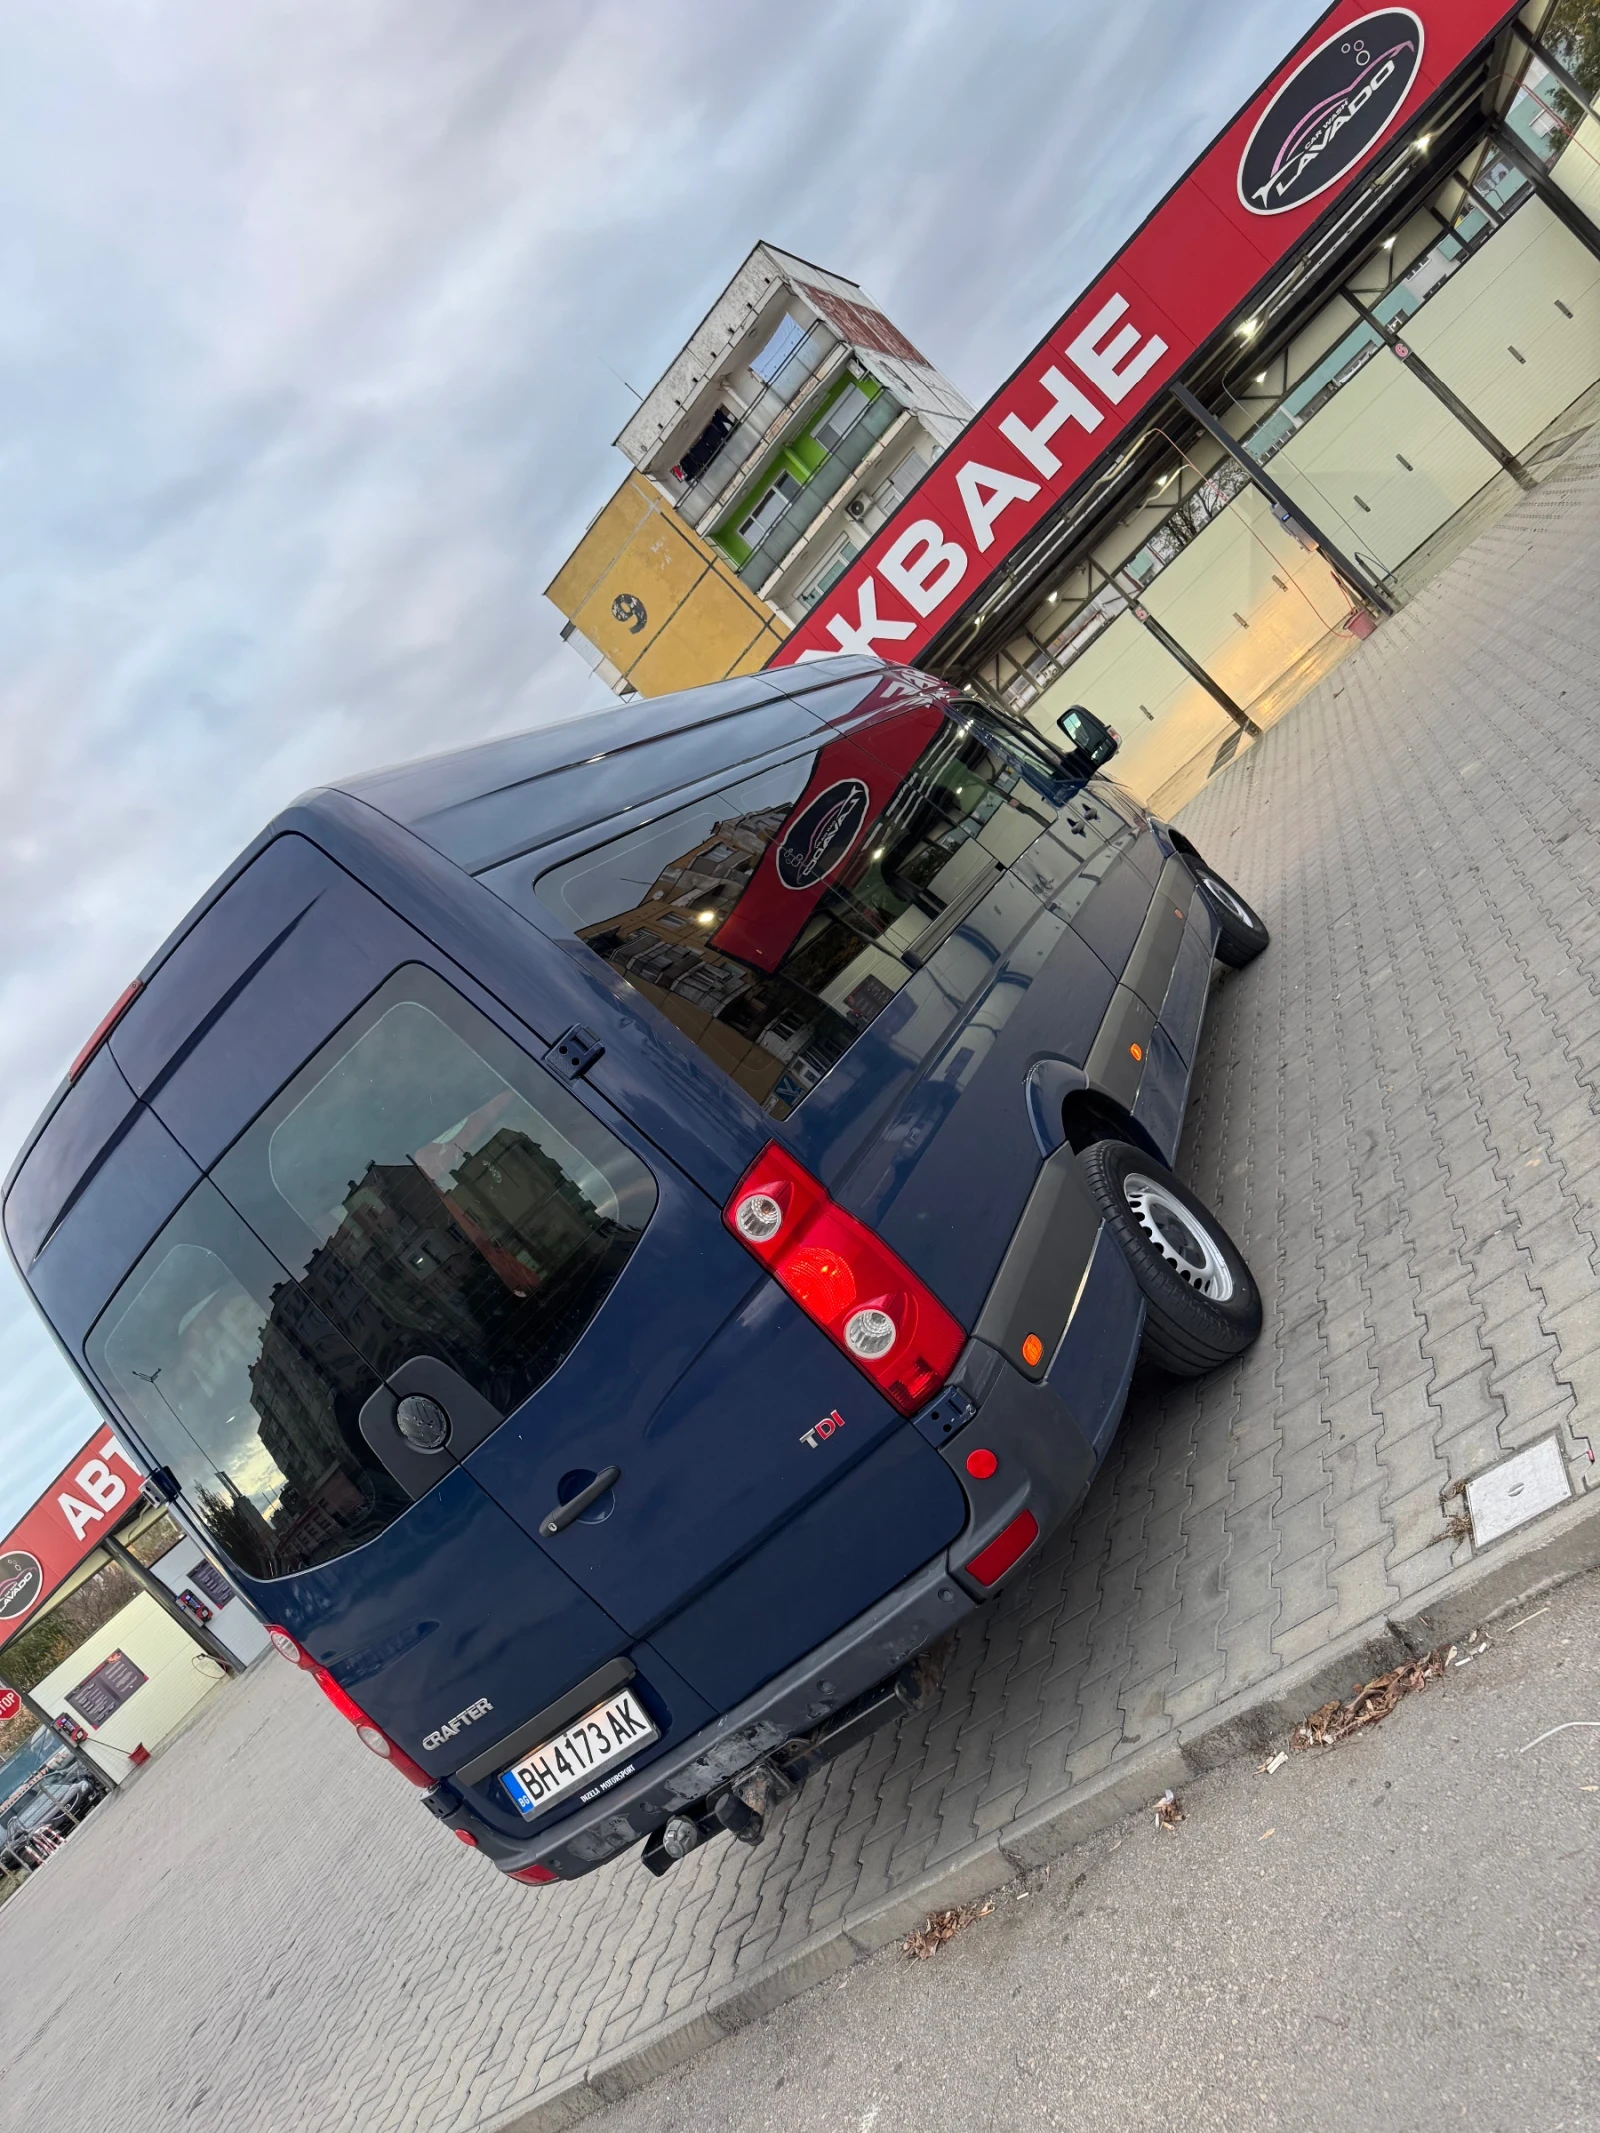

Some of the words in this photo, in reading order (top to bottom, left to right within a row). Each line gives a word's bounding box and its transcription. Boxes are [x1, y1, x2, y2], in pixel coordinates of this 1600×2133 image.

[1275, 59, 1396, 197] LAVADO
[1304, 129, 1323, 150] CAR
[1323, 100, 1349, 130] WASH
[1394, 343, 1409, 358] 6
[795, 292, 1169, 664] КВАНЕ
[611, 593, 648, 635] 9
[799, 1409, 846, 1449] TDI
[0, 1692, 16, 1716] TOP
[422, 1697, 495, 1751] CRAFTER
[518, 1756, 559, 1801] BH
[553, 1722, 611, 1778] 4173
[605, 1698, 647, 1745] AK
[517, 1795, 530, 1807] BG
[579, 1787, 601, 1803] DIZELA
[599, 1764, 636, 1791] MOTORSPORT
